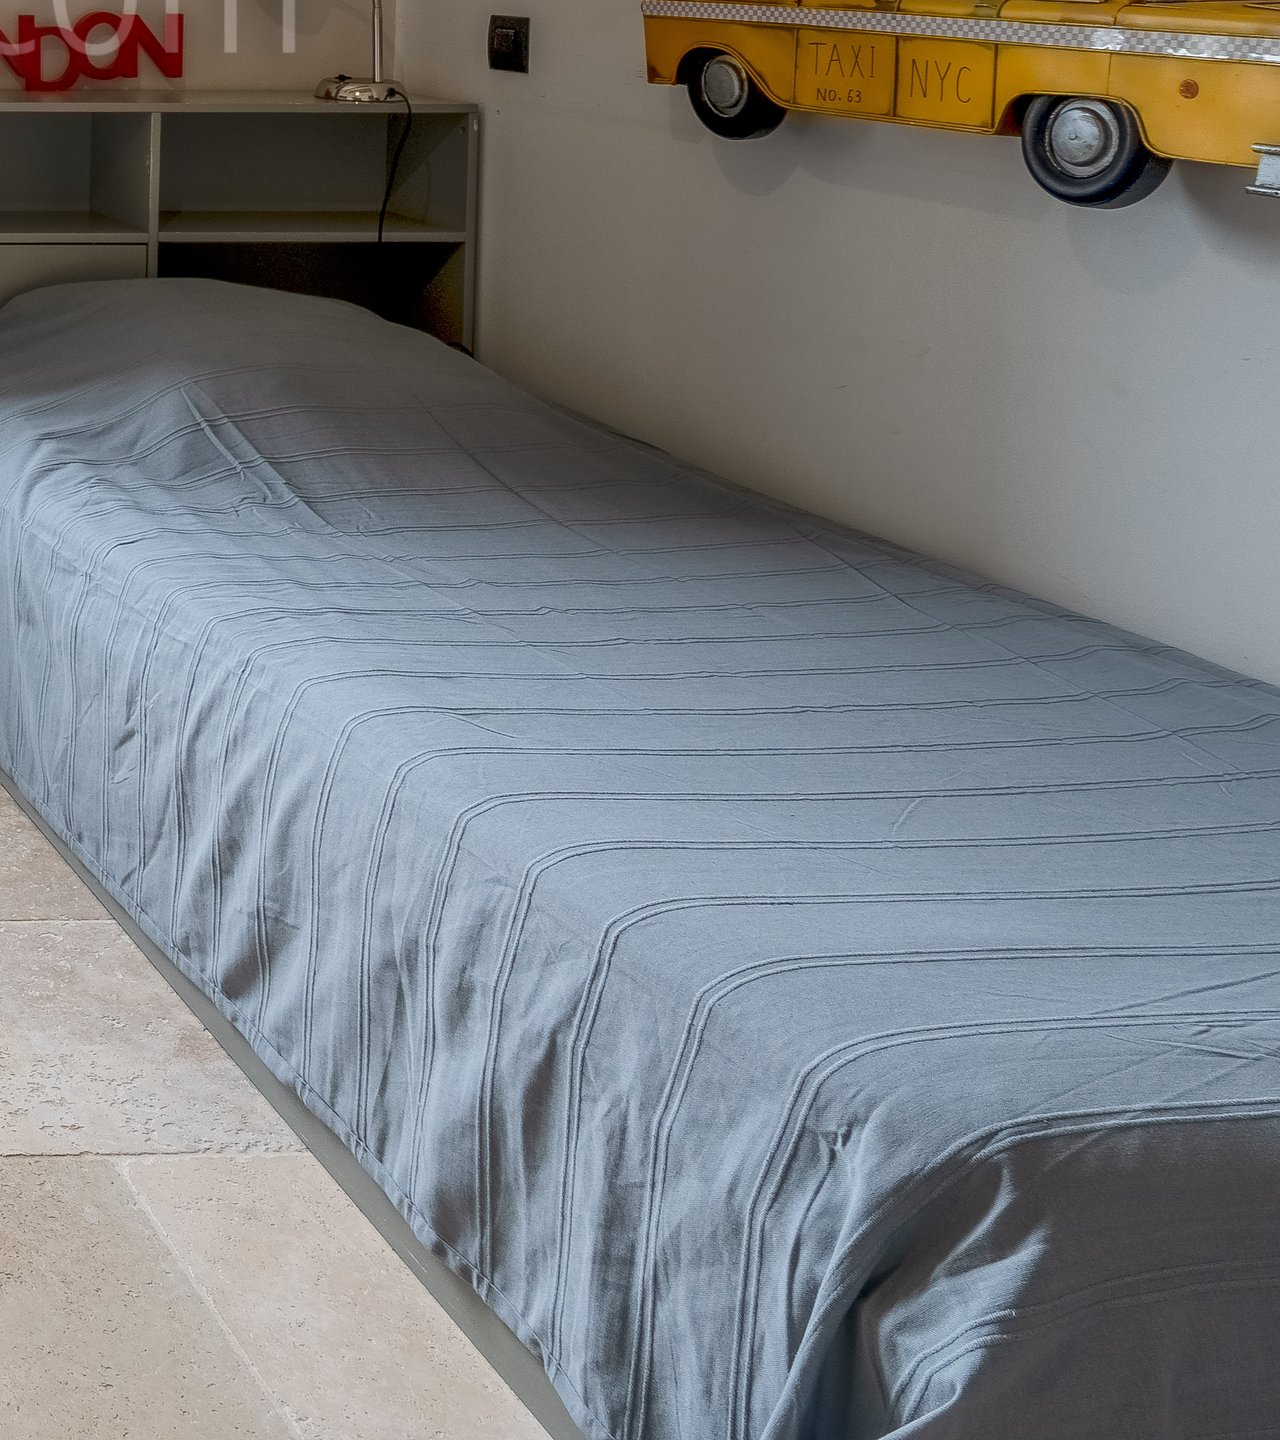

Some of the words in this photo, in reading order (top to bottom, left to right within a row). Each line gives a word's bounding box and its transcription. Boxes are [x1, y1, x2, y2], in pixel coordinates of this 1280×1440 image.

[808, 42, 876, 79] TAXI
[847, 89, 863, 103] 63
[910, 58, 972, 104] NYC
